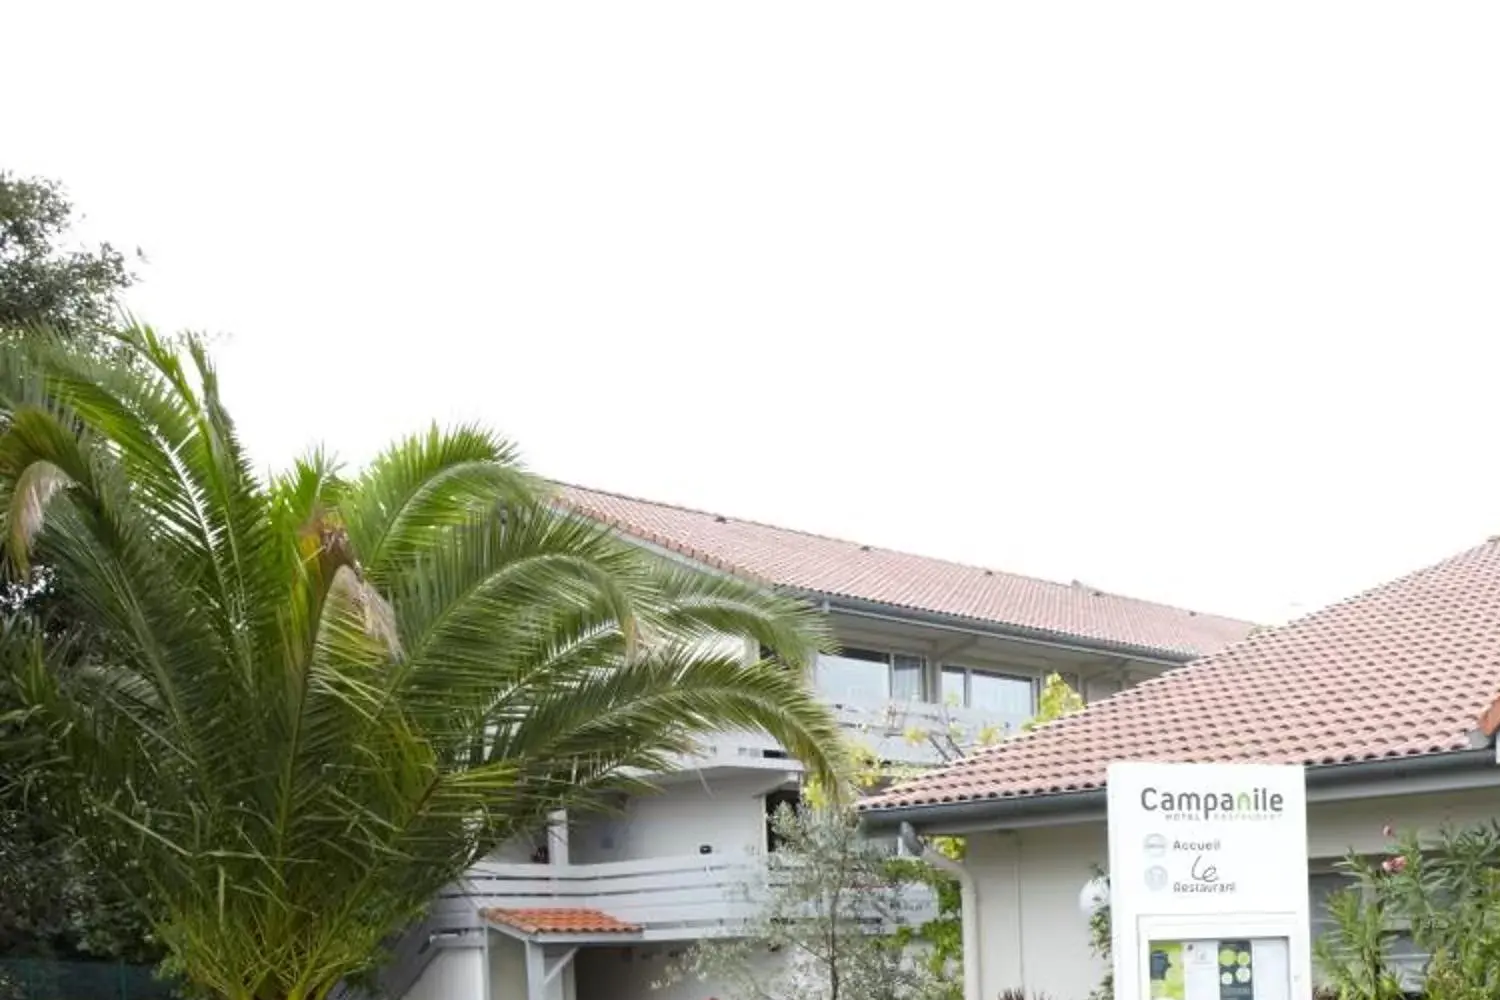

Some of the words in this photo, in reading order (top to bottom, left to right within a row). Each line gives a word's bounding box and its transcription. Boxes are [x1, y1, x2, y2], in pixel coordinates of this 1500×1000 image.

[1140, 787, 1284, 820] Campanile
[1173, 838, 1221, 851] Accueil
[1190, 854, 1219, 882] Le
[1173, 880, 1237, 893] Restaurant
